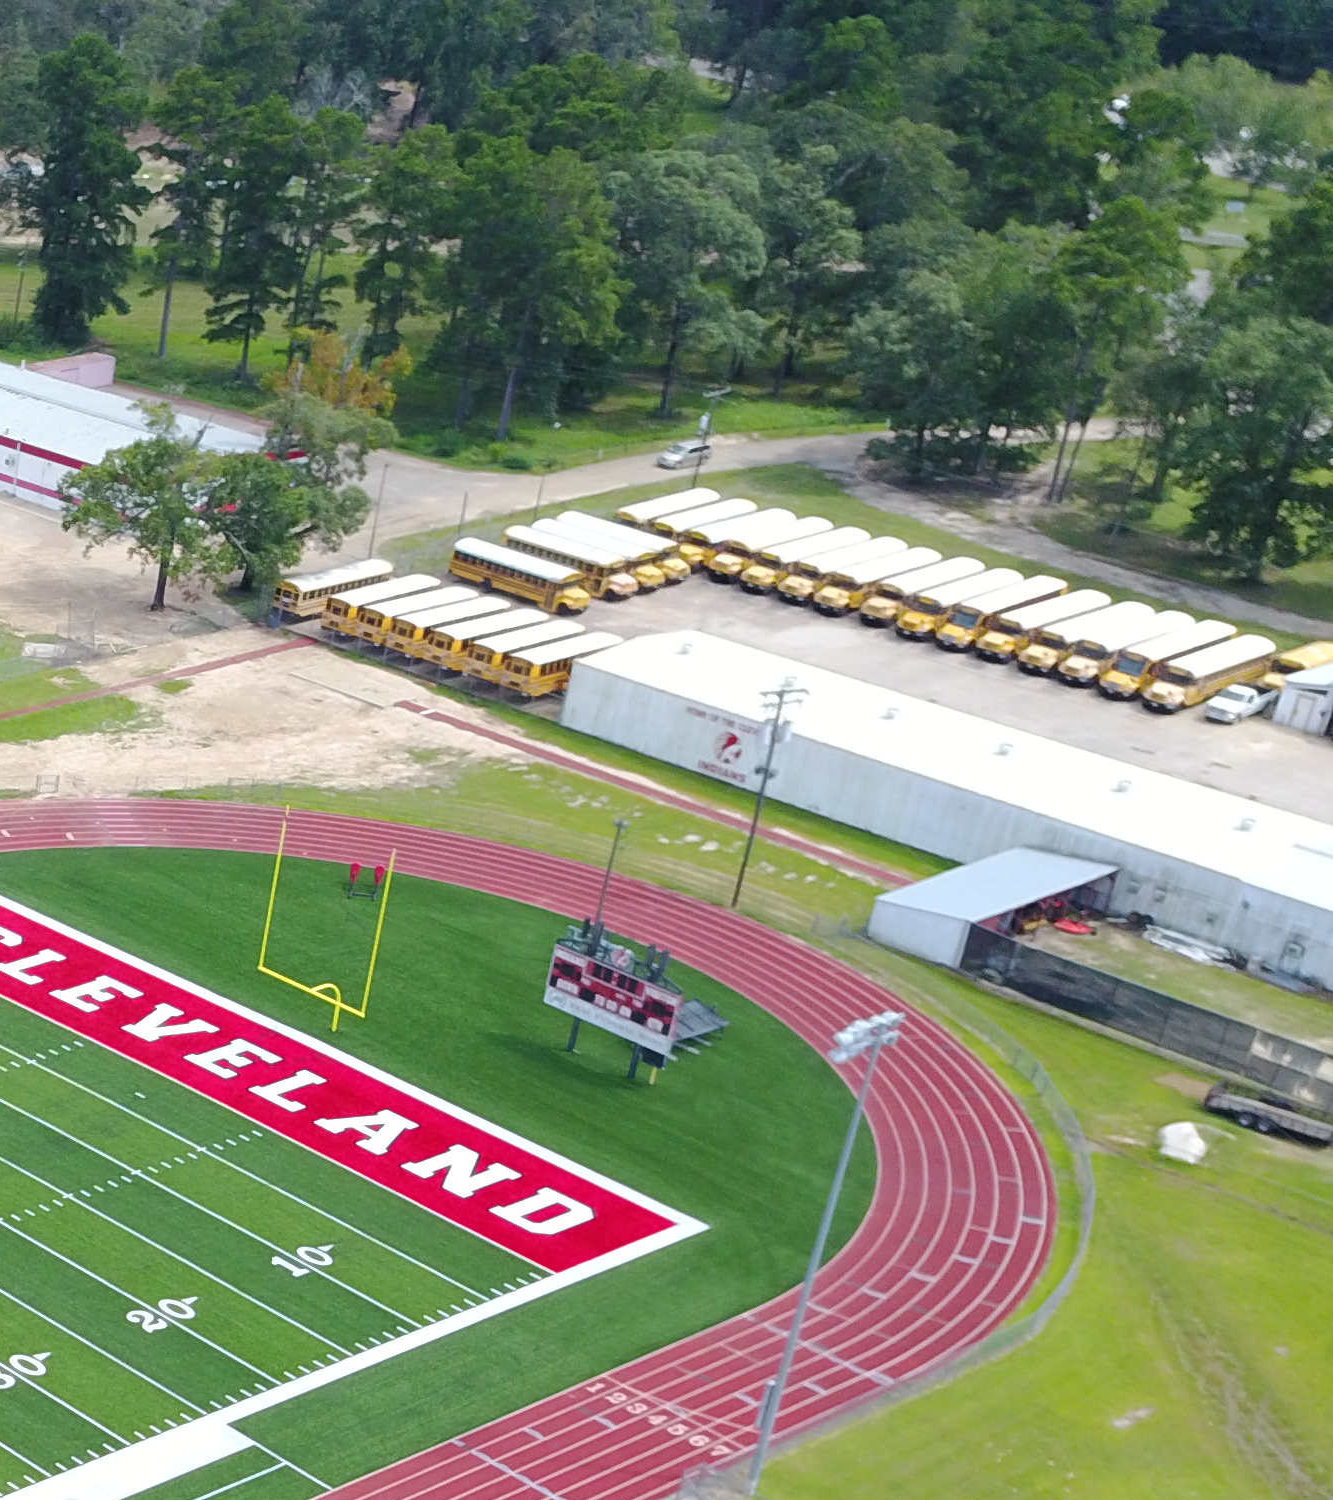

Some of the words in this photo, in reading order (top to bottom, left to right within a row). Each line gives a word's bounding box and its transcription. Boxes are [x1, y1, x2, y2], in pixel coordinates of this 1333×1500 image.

[272, 1245, 335, 1281] 10
[126, 1297, 197, 1335] 20
[585, 1382, 605, 1392] 1
[604, 1391, 628, 1403] 2
[626, 1402, 648, 1413] 3
[648, 1414, 669, 1425] 4
[667, 1424, 689, 1435] 5
[688, 1435, 710, 1446] 6
[709, 1445, 734, 1457] 7
